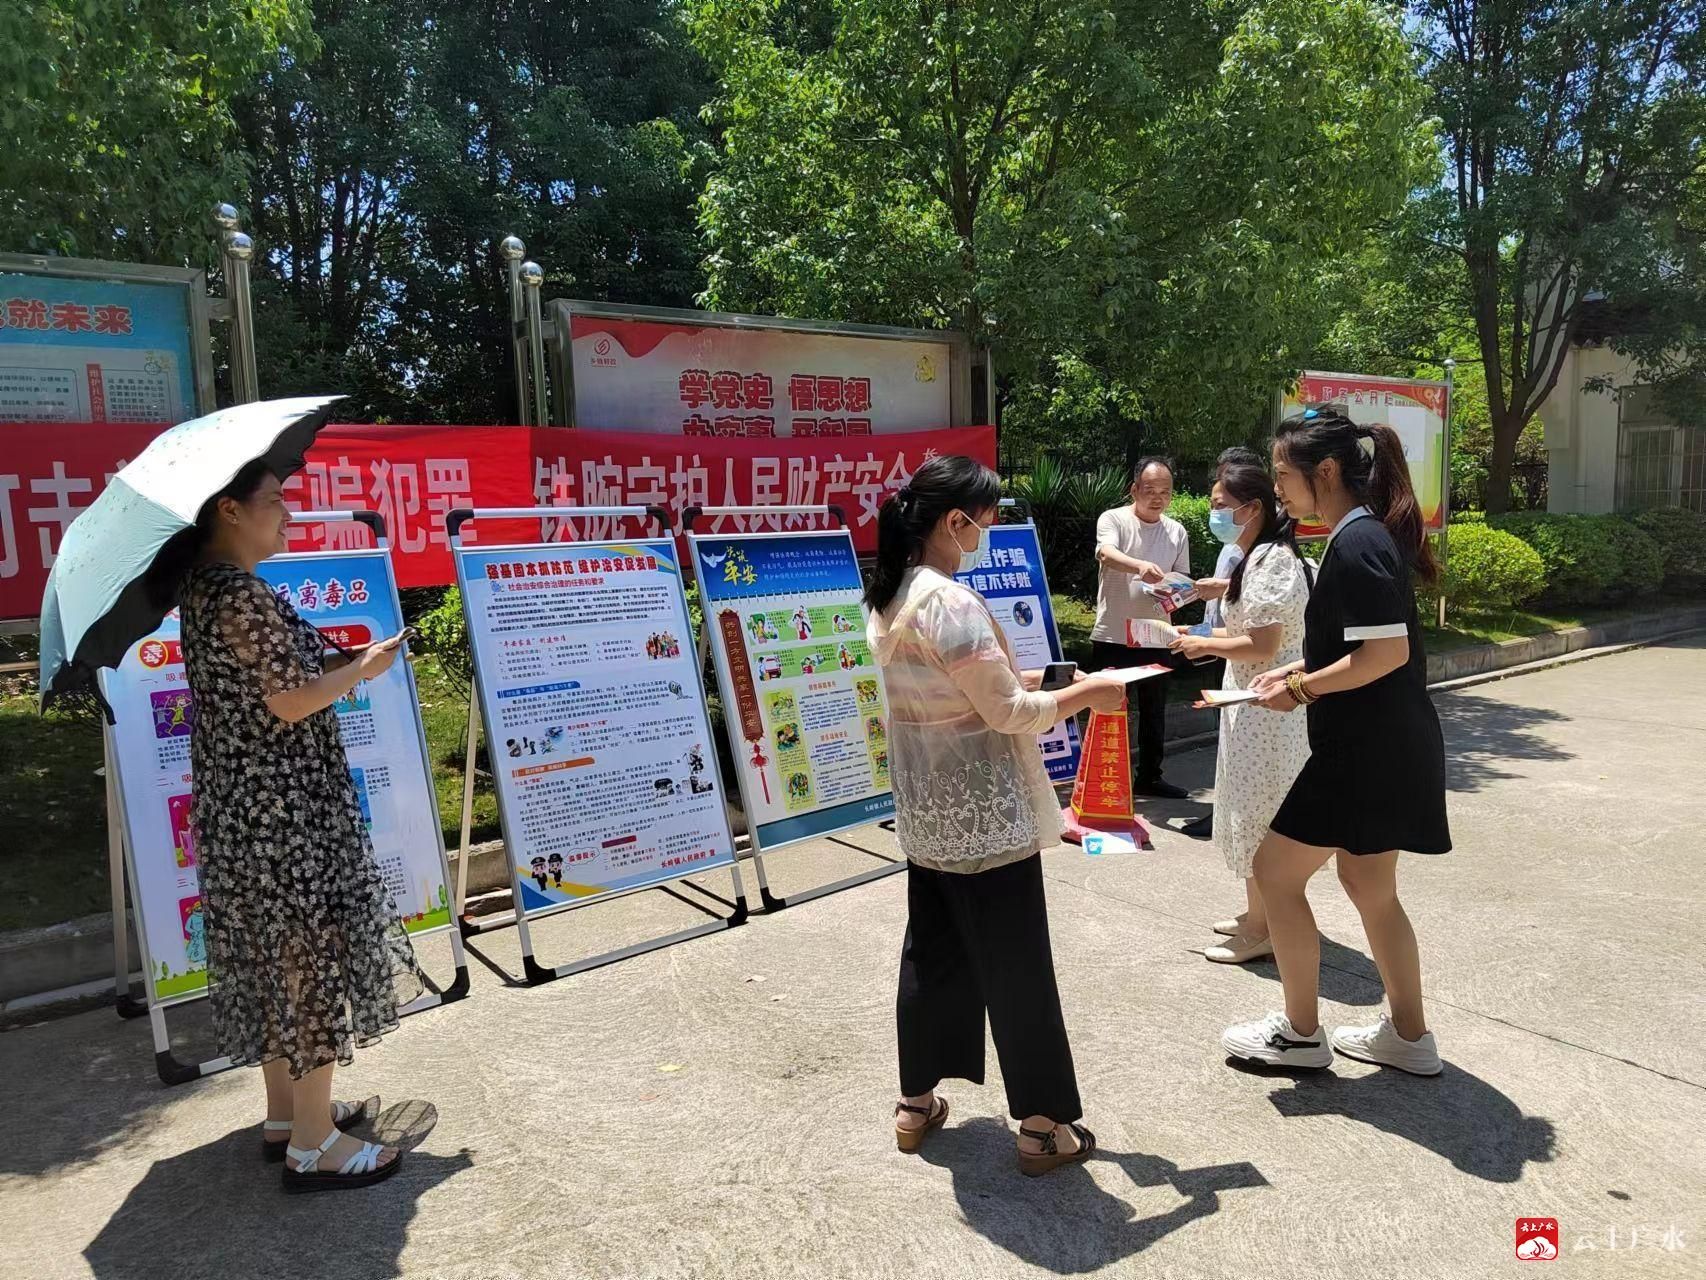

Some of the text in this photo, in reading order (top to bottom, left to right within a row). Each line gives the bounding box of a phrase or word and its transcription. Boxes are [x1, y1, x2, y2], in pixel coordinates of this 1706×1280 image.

[0, 297, 133, 335] 就未来
[680, 369, 872, 412] 学党史 悟思想
[486, 555, 658, 580] 强基固本抓防范 维护治安促发展
[723, 560, 758, 586] 平安
